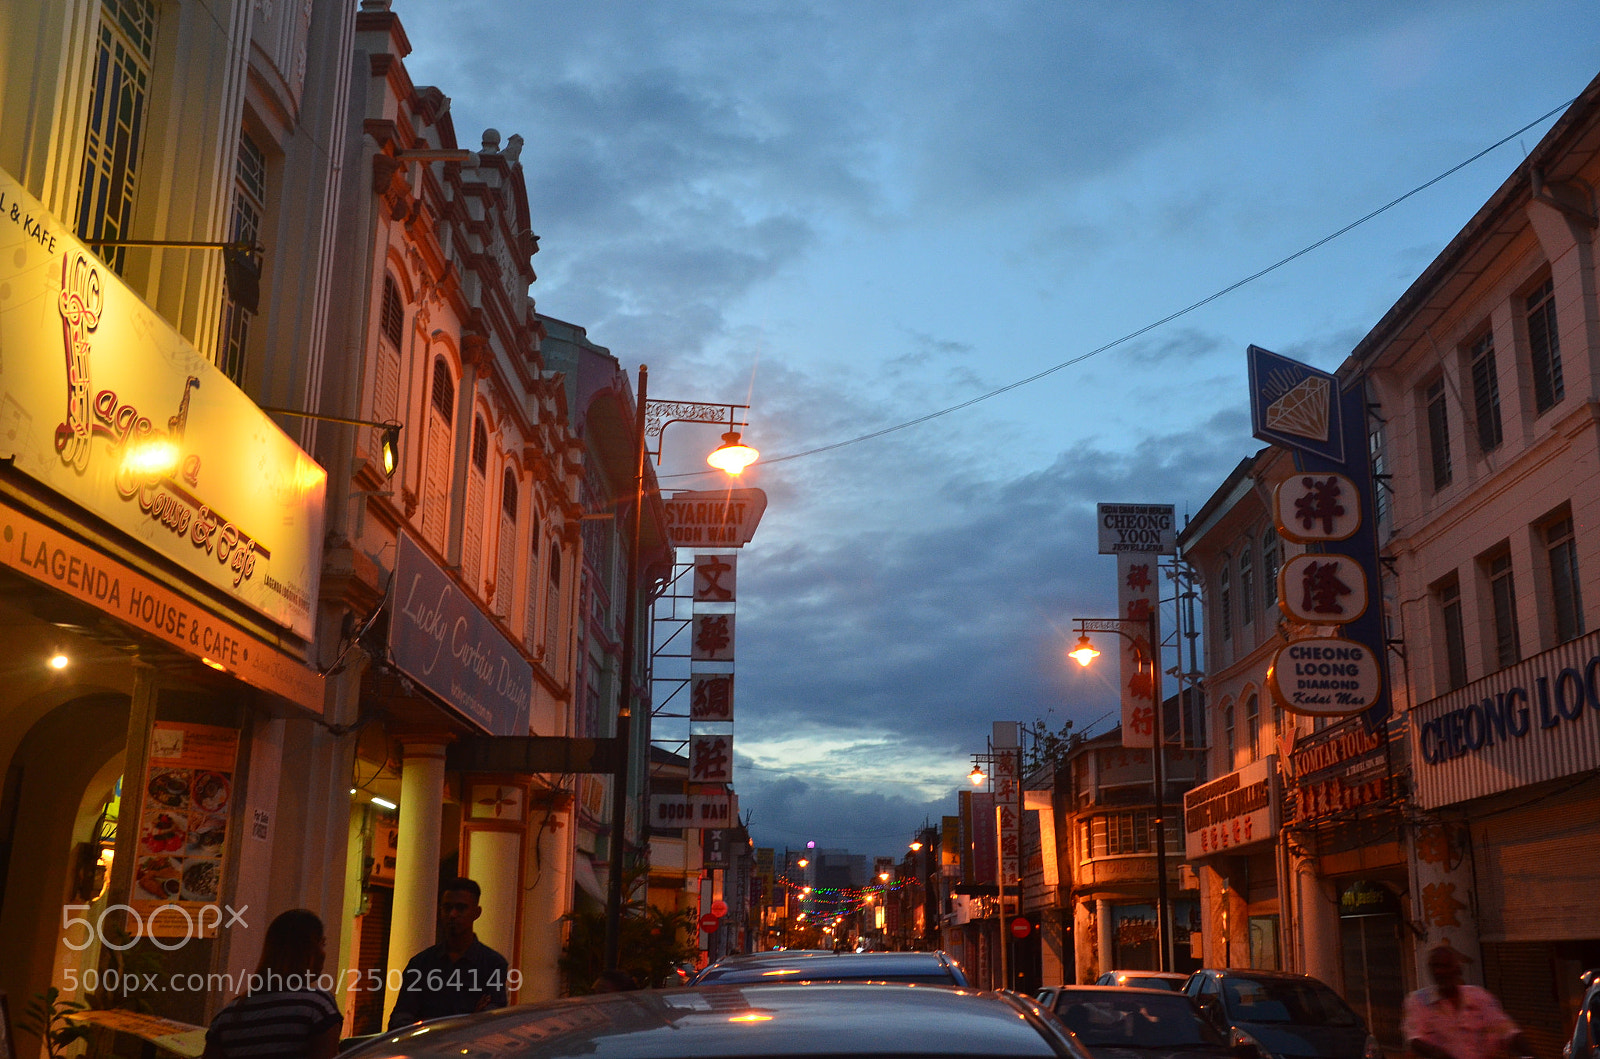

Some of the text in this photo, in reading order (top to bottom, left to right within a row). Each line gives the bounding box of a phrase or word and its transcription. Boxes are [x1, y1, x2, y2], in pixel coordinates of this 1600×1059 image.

[10, 202, 23, 223] &
[24, 214, 57, 255] KAFE
[665, 502, 746, 526] SYARIKAT
[1104, 514, 1170, 530] CHEONG
[707, 526, 737, 542] WAH
[1117, 529, 1161, 544] YOON
[191, 504, 217, 552] &
[217, 518, 257, 589] Cafe
[20, 531, 240, 667] LAGENDA HOUSE & CAFE
[402, 573, 451, 676] Lucky
[1290, 645, 1363, 661] CHEONG
[1296, 662, 1359, 677] LOONG
[1298, 679, 1360, 690] DIAMOND
[1293, 690, 1365, 706] Kedai Mas
[1421, 687, 1530, 766] CHEONG
[1294, 739, 1340, 778] KOMTAR
[658, 803, 728, 820] BOON WAH
